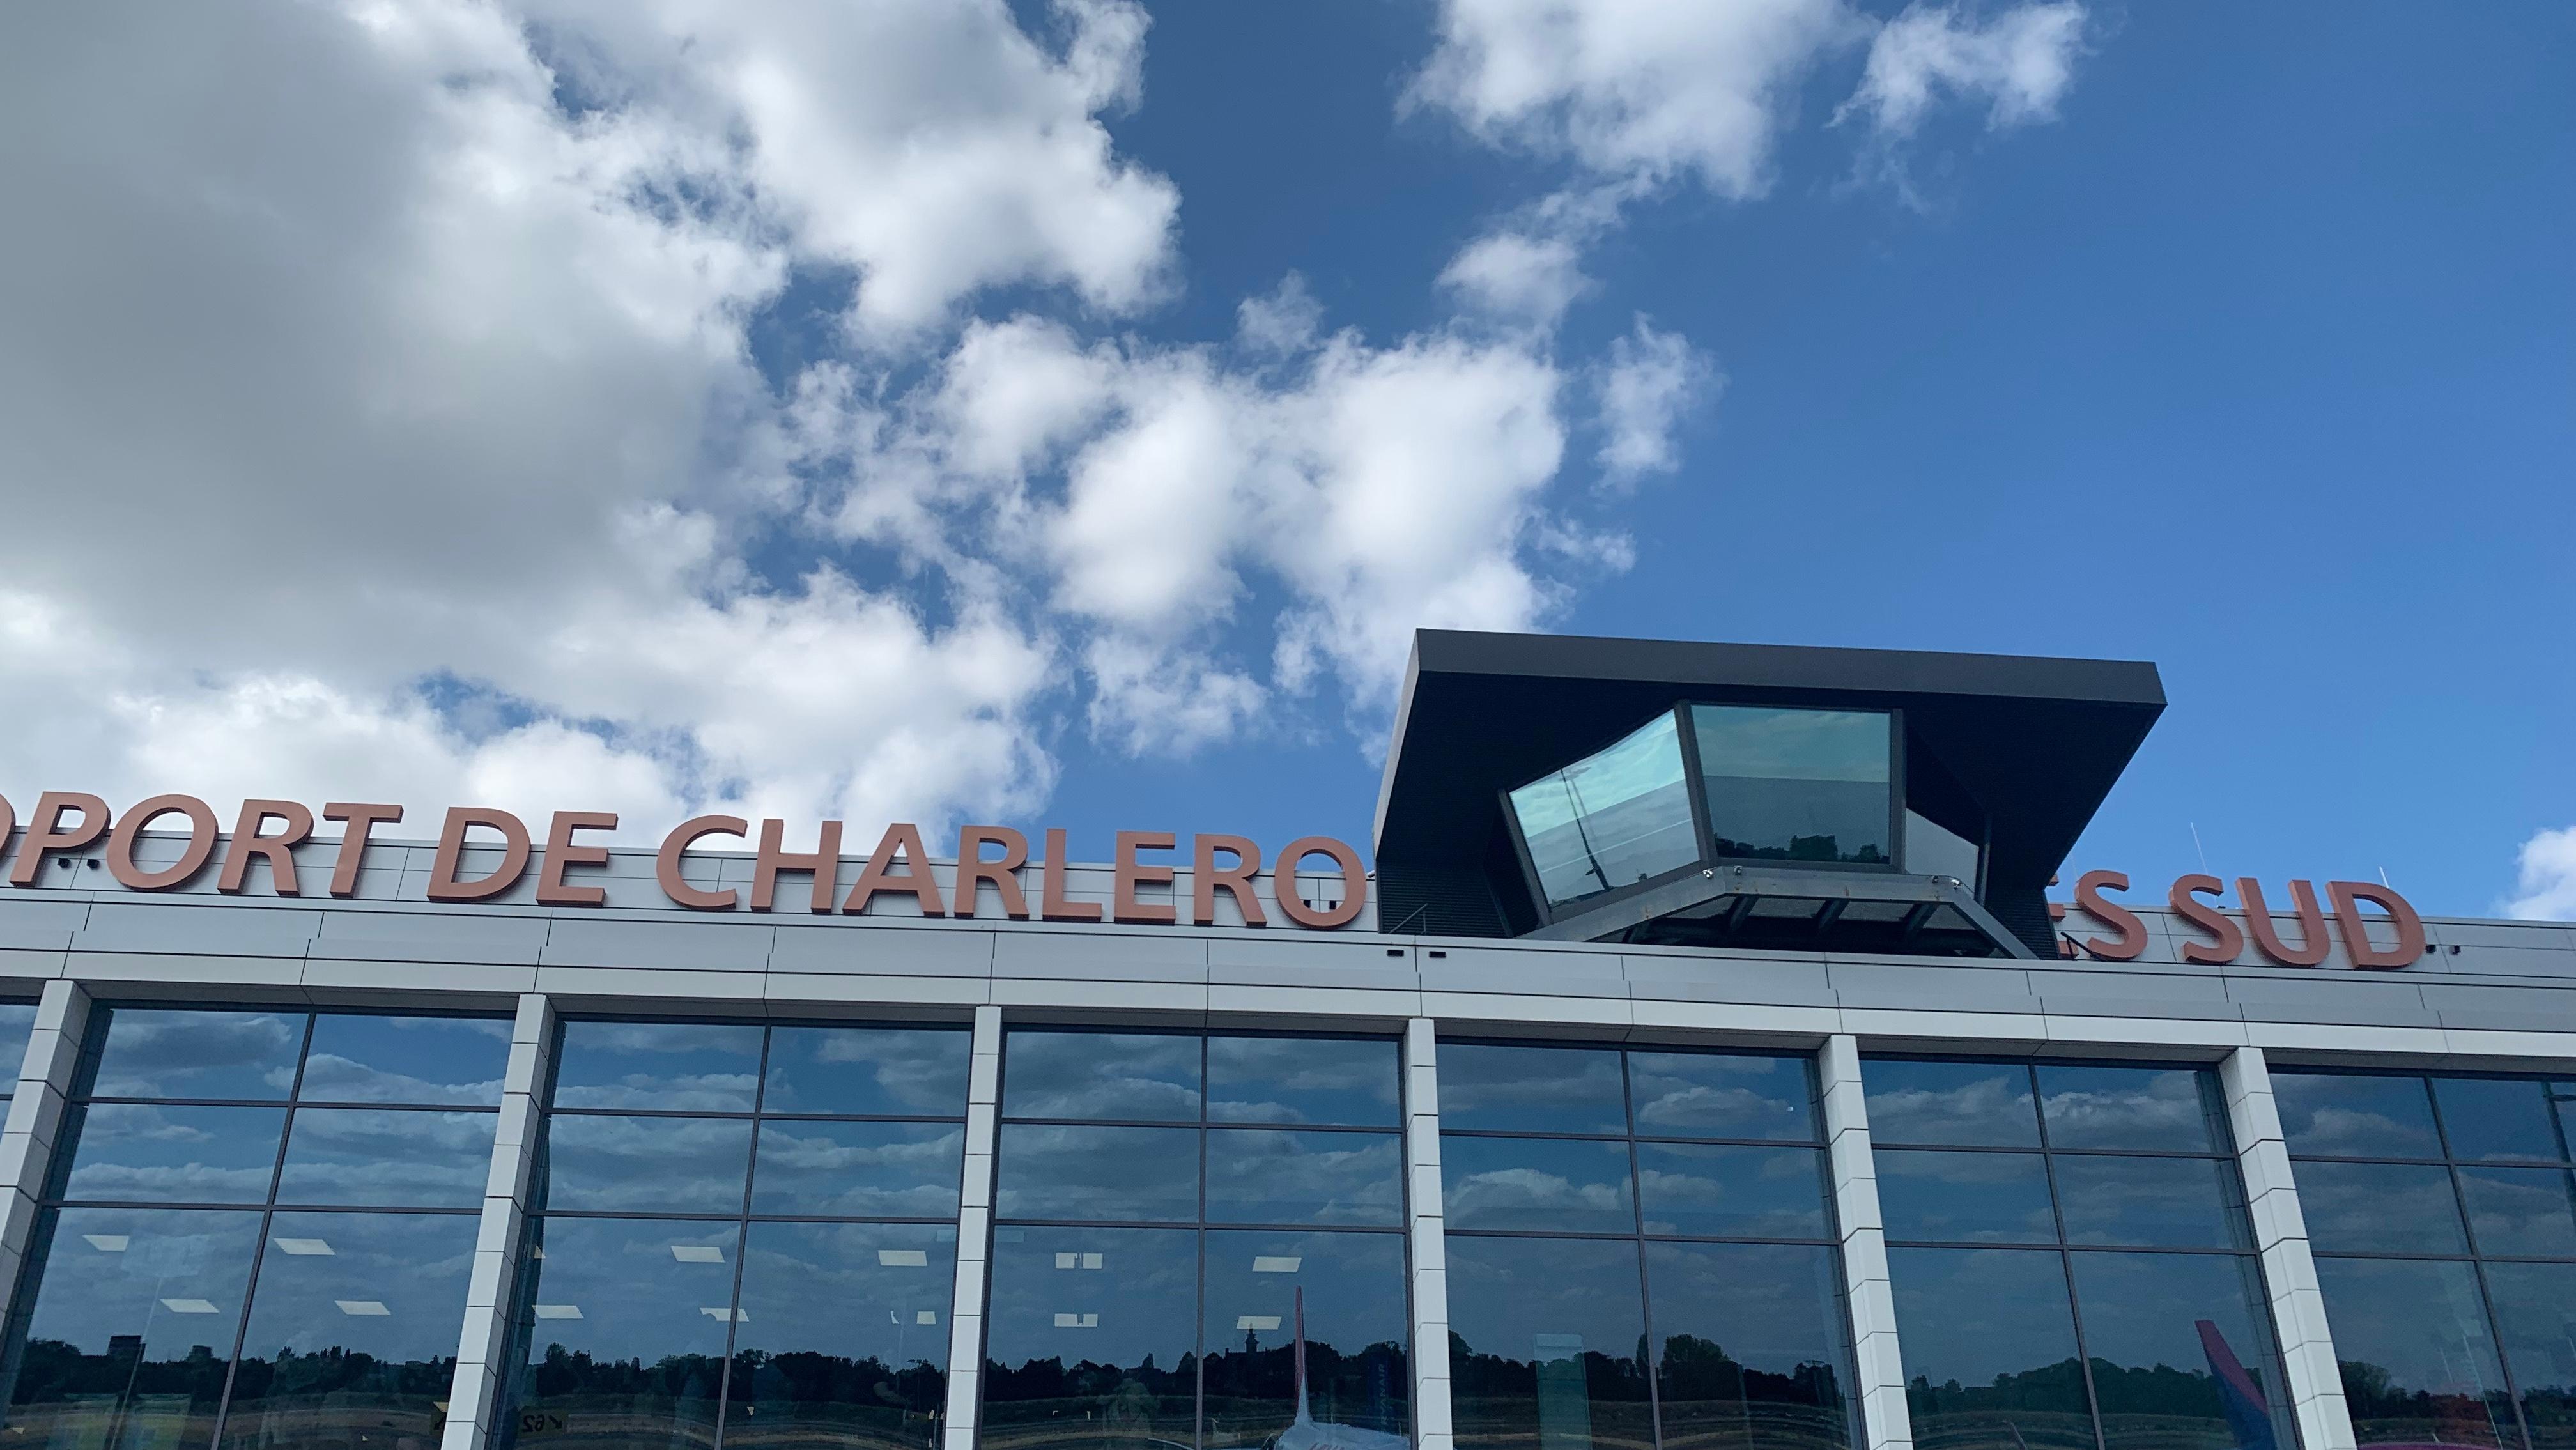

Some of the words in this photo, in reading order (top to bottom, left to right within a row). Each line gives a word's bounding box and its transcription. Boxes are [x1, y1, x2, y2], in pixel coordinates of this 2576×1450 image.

[0, 791, 404, 899] PORT
[427, 807, 618, 907] DE
[656, 815, 1367, 930] CHARLERO
[2169, 874, 2426, 970] SUD
